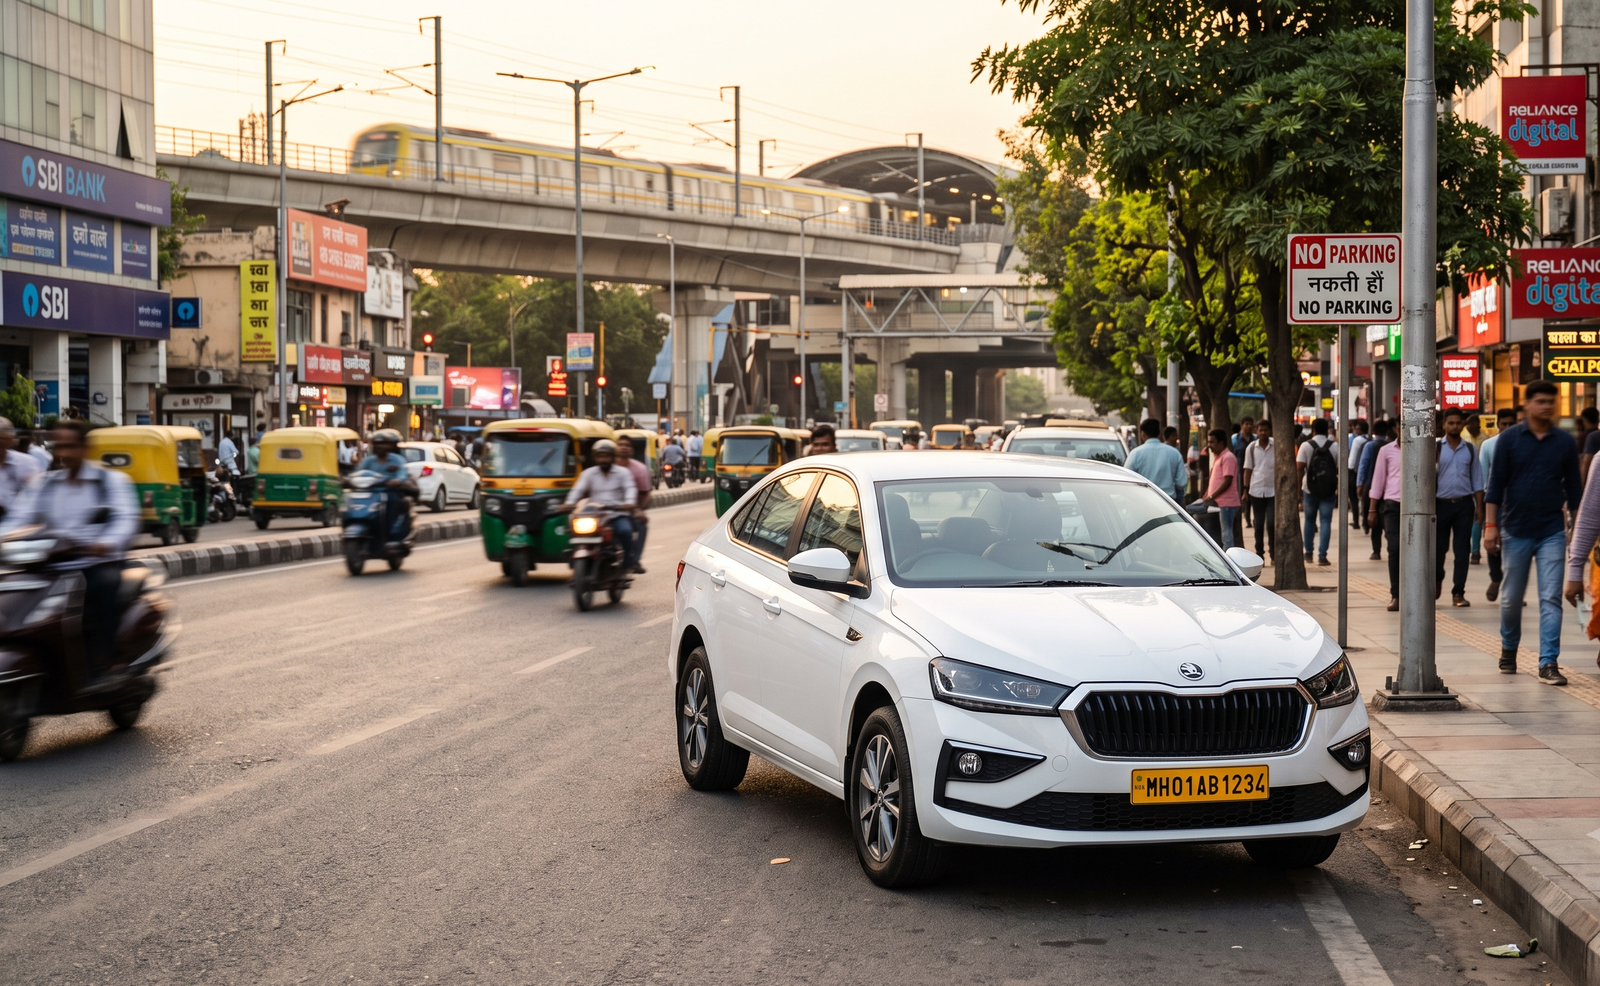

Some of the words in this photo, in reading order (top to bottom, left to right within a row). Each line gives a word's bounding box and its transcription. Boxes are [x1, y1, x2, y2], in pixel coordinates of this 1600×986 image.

[1509, 117, 1579, 147] digital
[37, 158, 63, 193] SBI
[65, 166, 106, 203] BANK
[1295, 243, 1323, 265] NO
[1330, 244, 1395, 264] PARKING
[1307, 271, 1359, 292] नकती
[41, 285, 69, 320] SBI
[1299, 300, 1320, 314] NO
[1325, 300, 1393, 314] PARKING
[1579, 331, 1597, 344] का
[1547, 360, 1584, 374] CHAI
[1146, 773, 1265, 797] MH01AB1234
